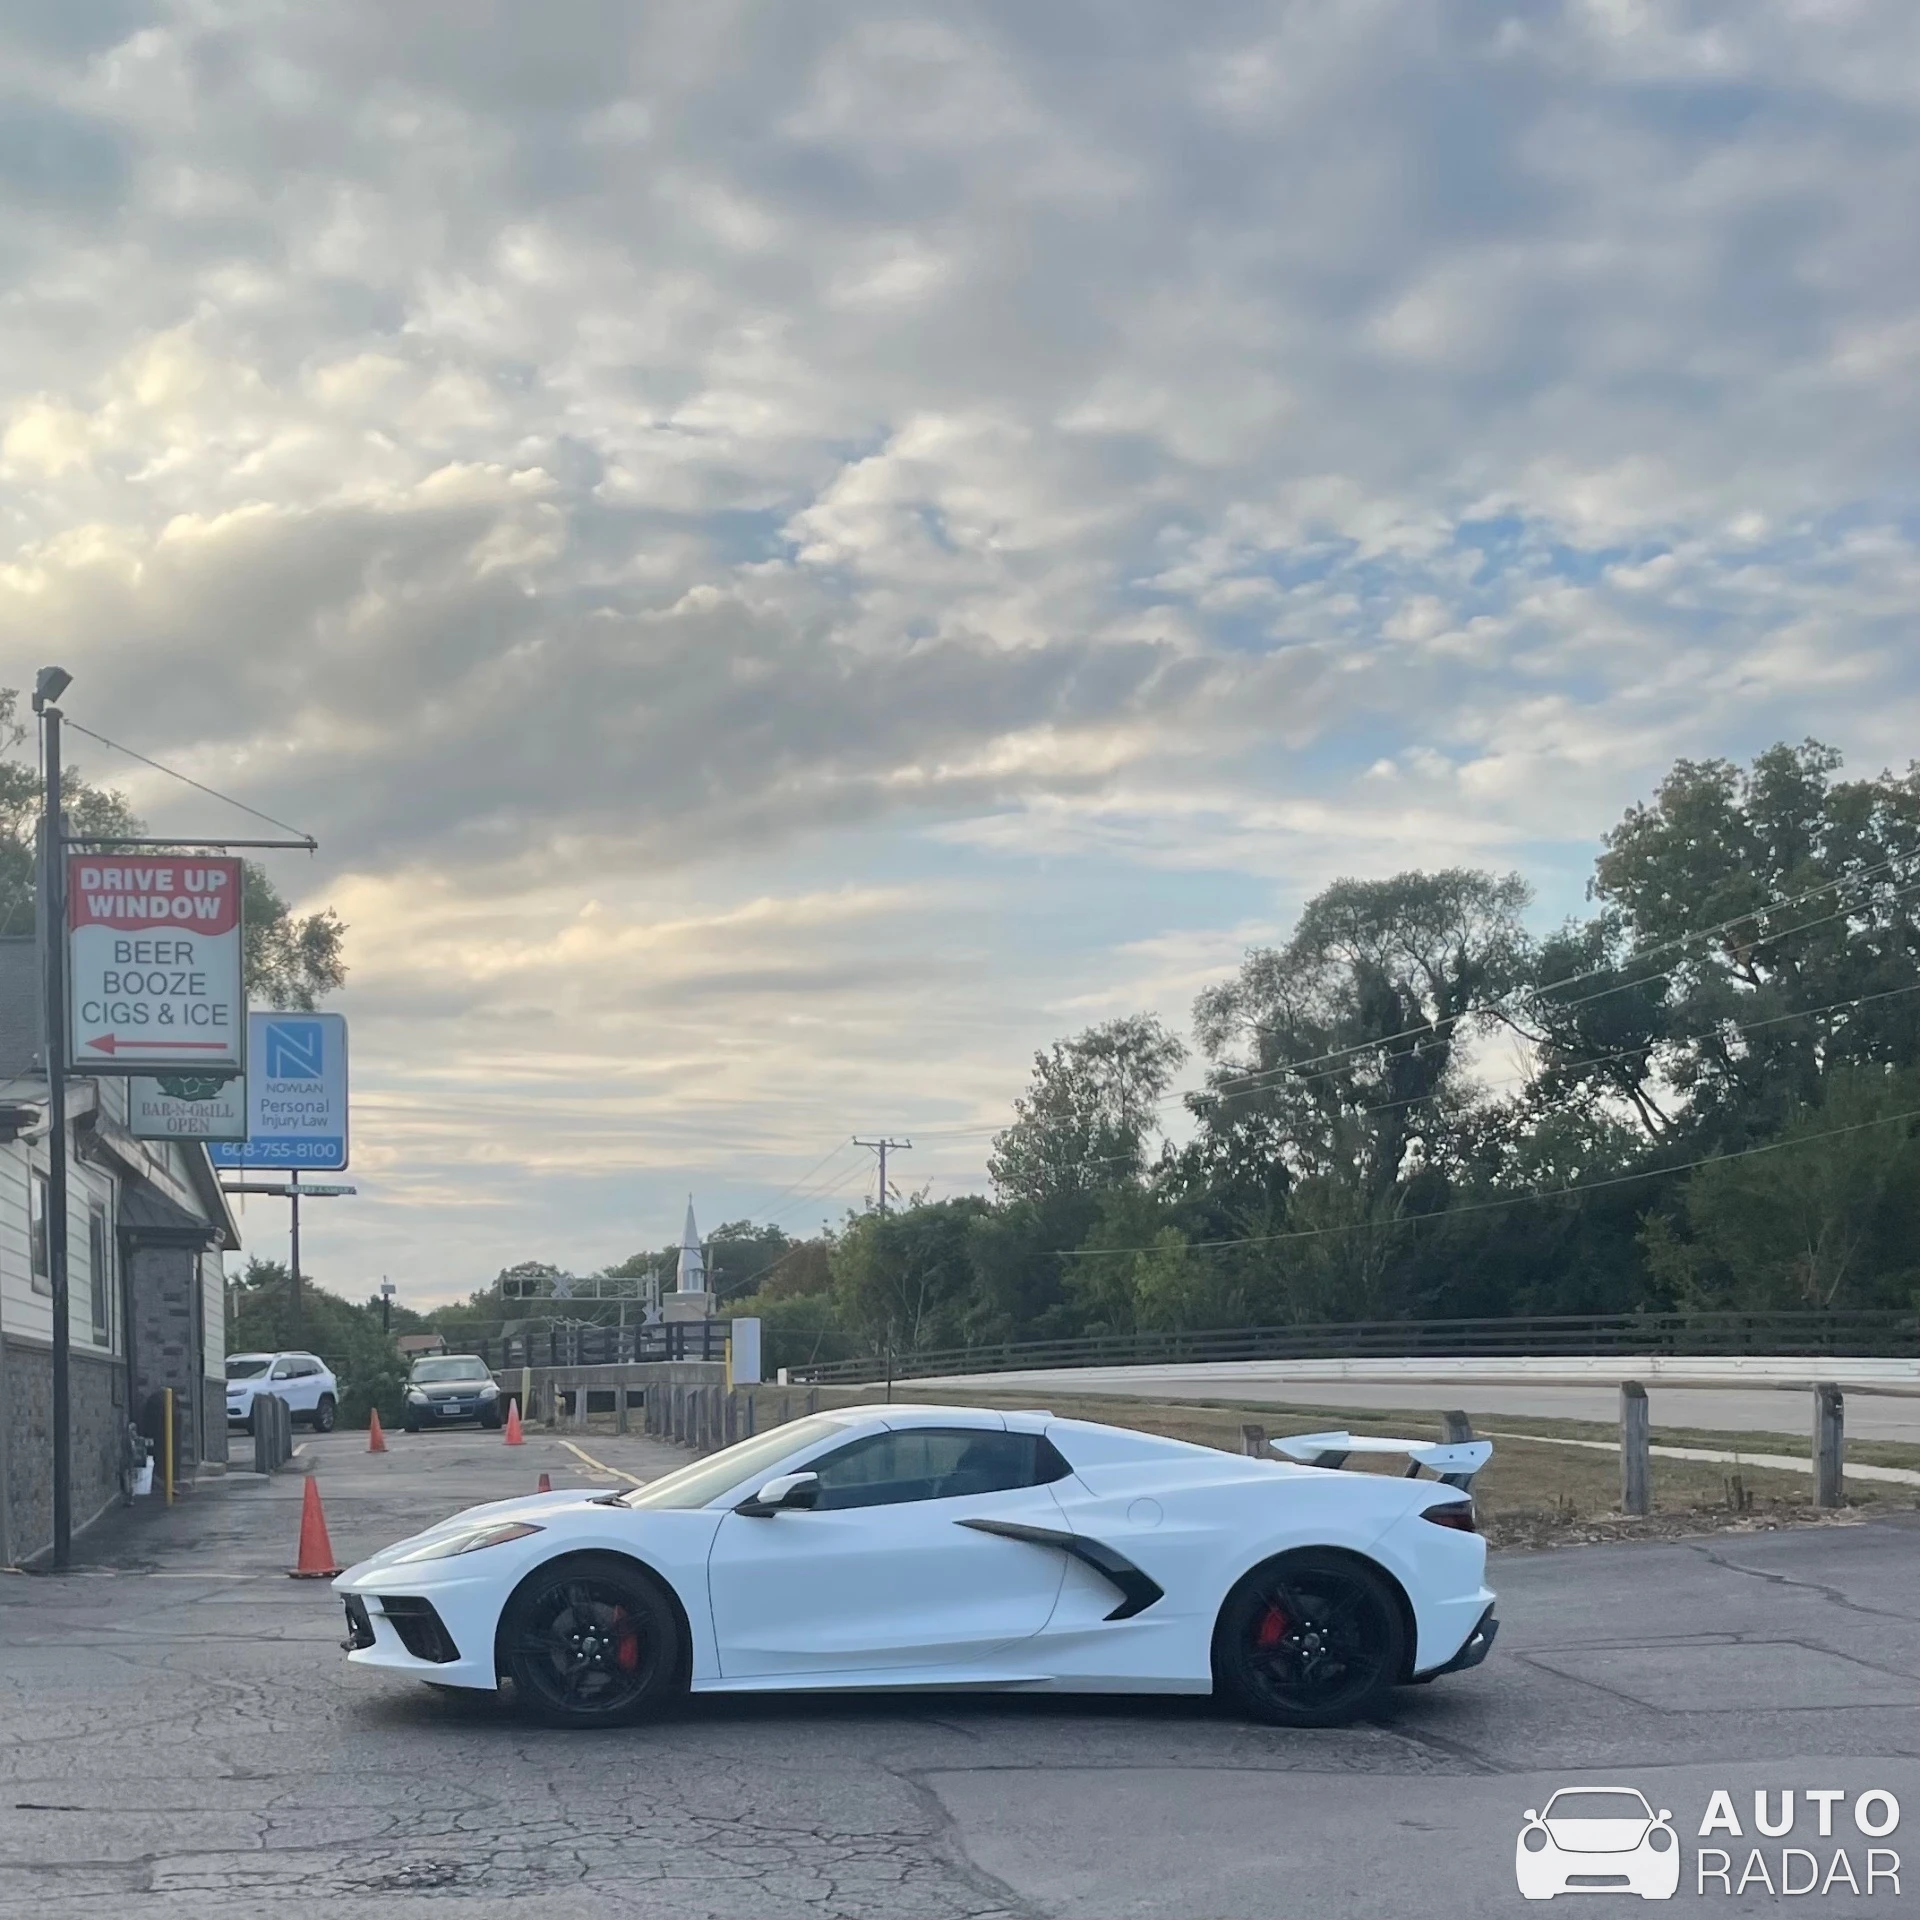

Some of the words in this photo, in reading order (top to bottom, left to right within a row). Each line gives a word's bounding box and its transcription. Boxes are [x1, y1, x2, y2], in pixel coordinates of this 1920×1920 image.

[80, 867, 174, 891] DRIVE
[184, 869, 228, 892] UP
[87, 895, 222, 919] WINDOW
[114, 940, 194, 965] BEER
[103, 971, 206, 996] BOOZE
[82, 1001, 150, 1025] CIGS
[157, 1003, 174, 1025] &
[184, 1003, 228, 1026] ICE
[266, 1083, 324, 1094] NOWLAN
[261, 1098, 330, 1113] Personal
[166, 1117, 211, 1133] OPEN
[261, 1114, 299, 1129] Injury
[301, 1114, 328, 1127] Law
